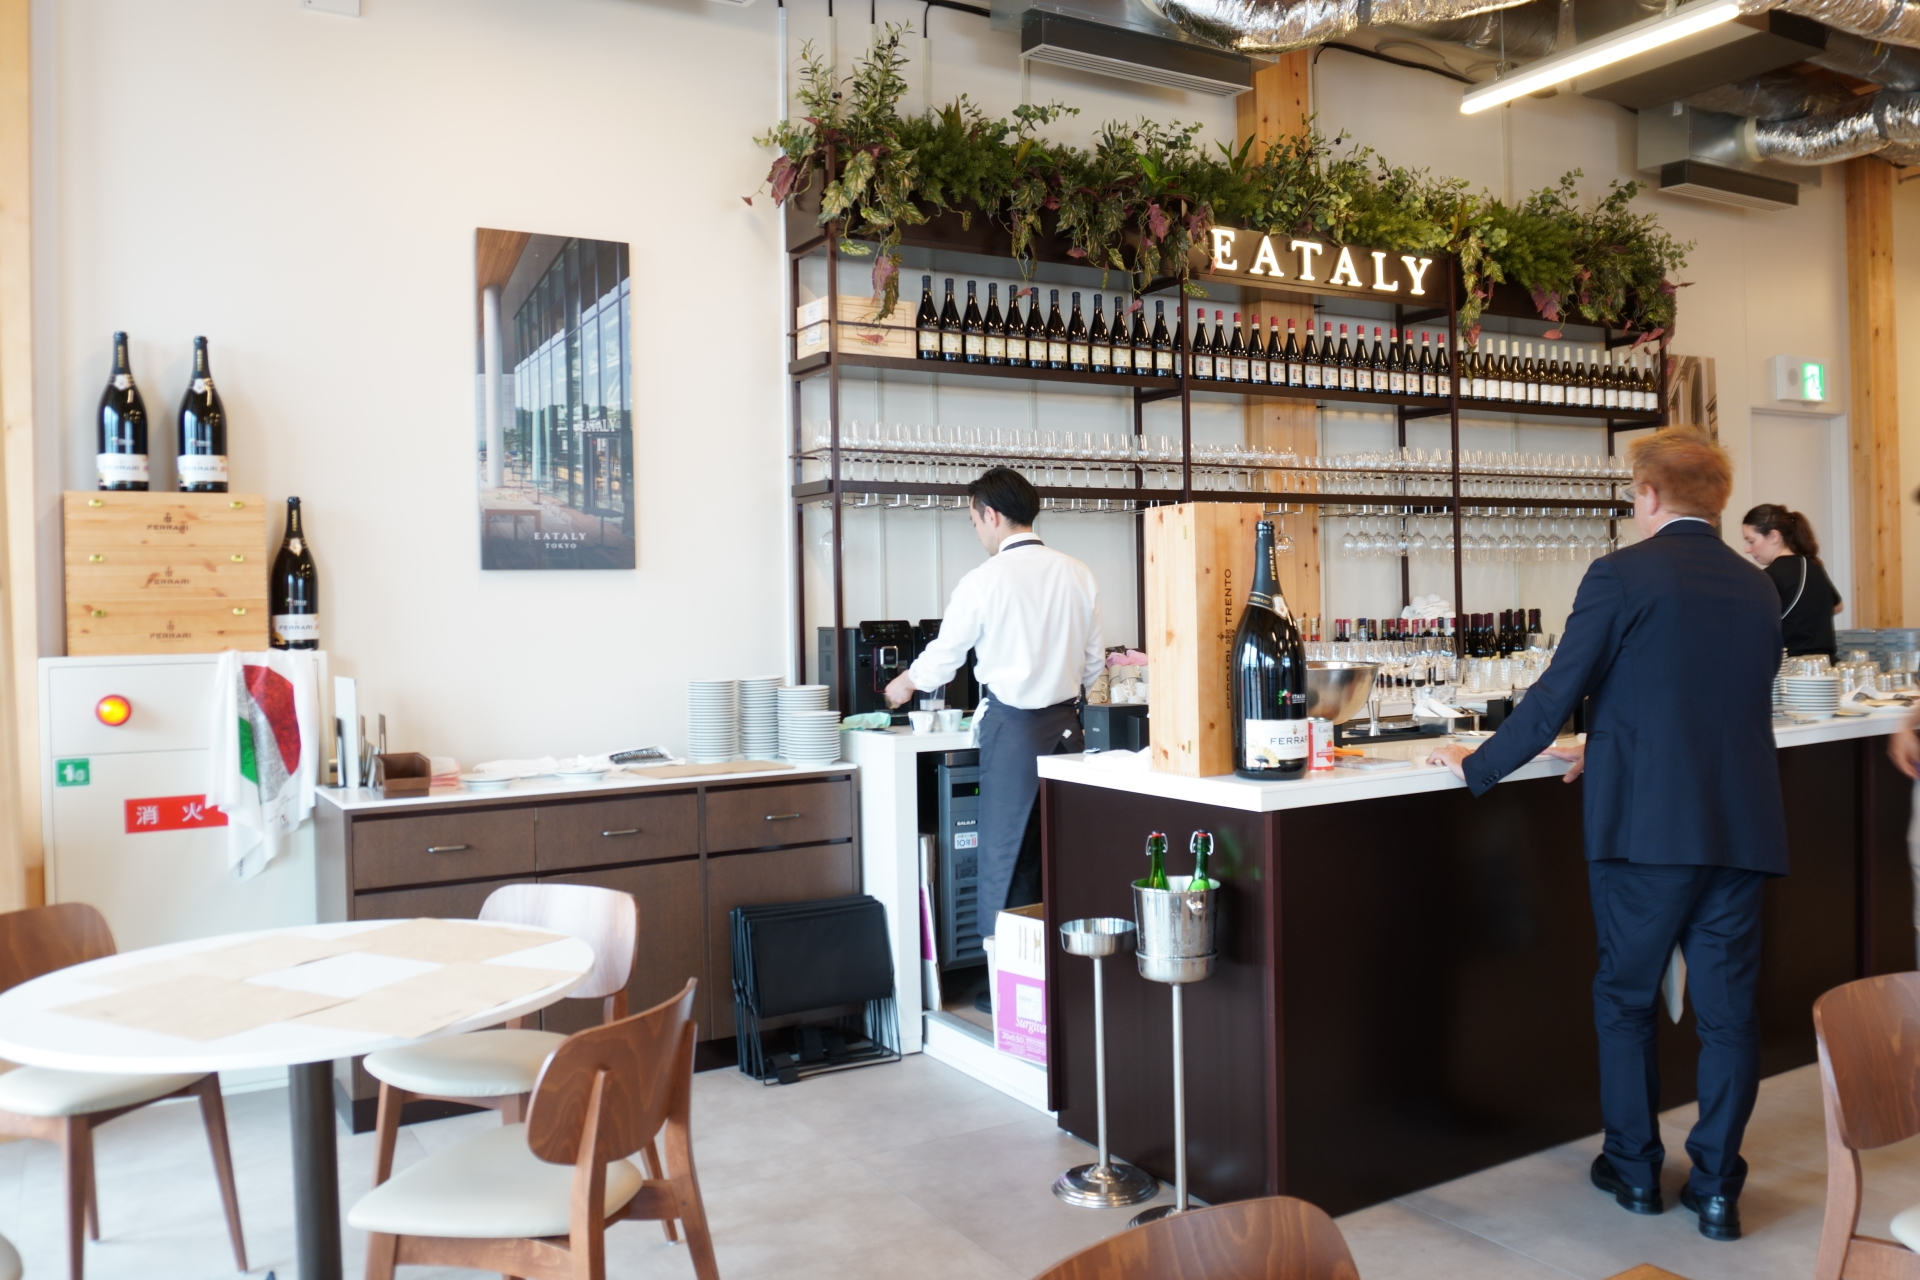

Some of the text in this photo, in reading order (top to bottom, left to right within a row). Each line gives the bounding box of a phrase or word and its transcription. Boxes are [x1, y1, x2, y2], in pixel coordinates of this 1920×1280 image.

[1211, 228, 1433, 295] EATALY
[581, 418, 617, 432] EATALY
[533, 532, 587, 541] EATALY
[1224, 568, 1233, 626] TRENTO
